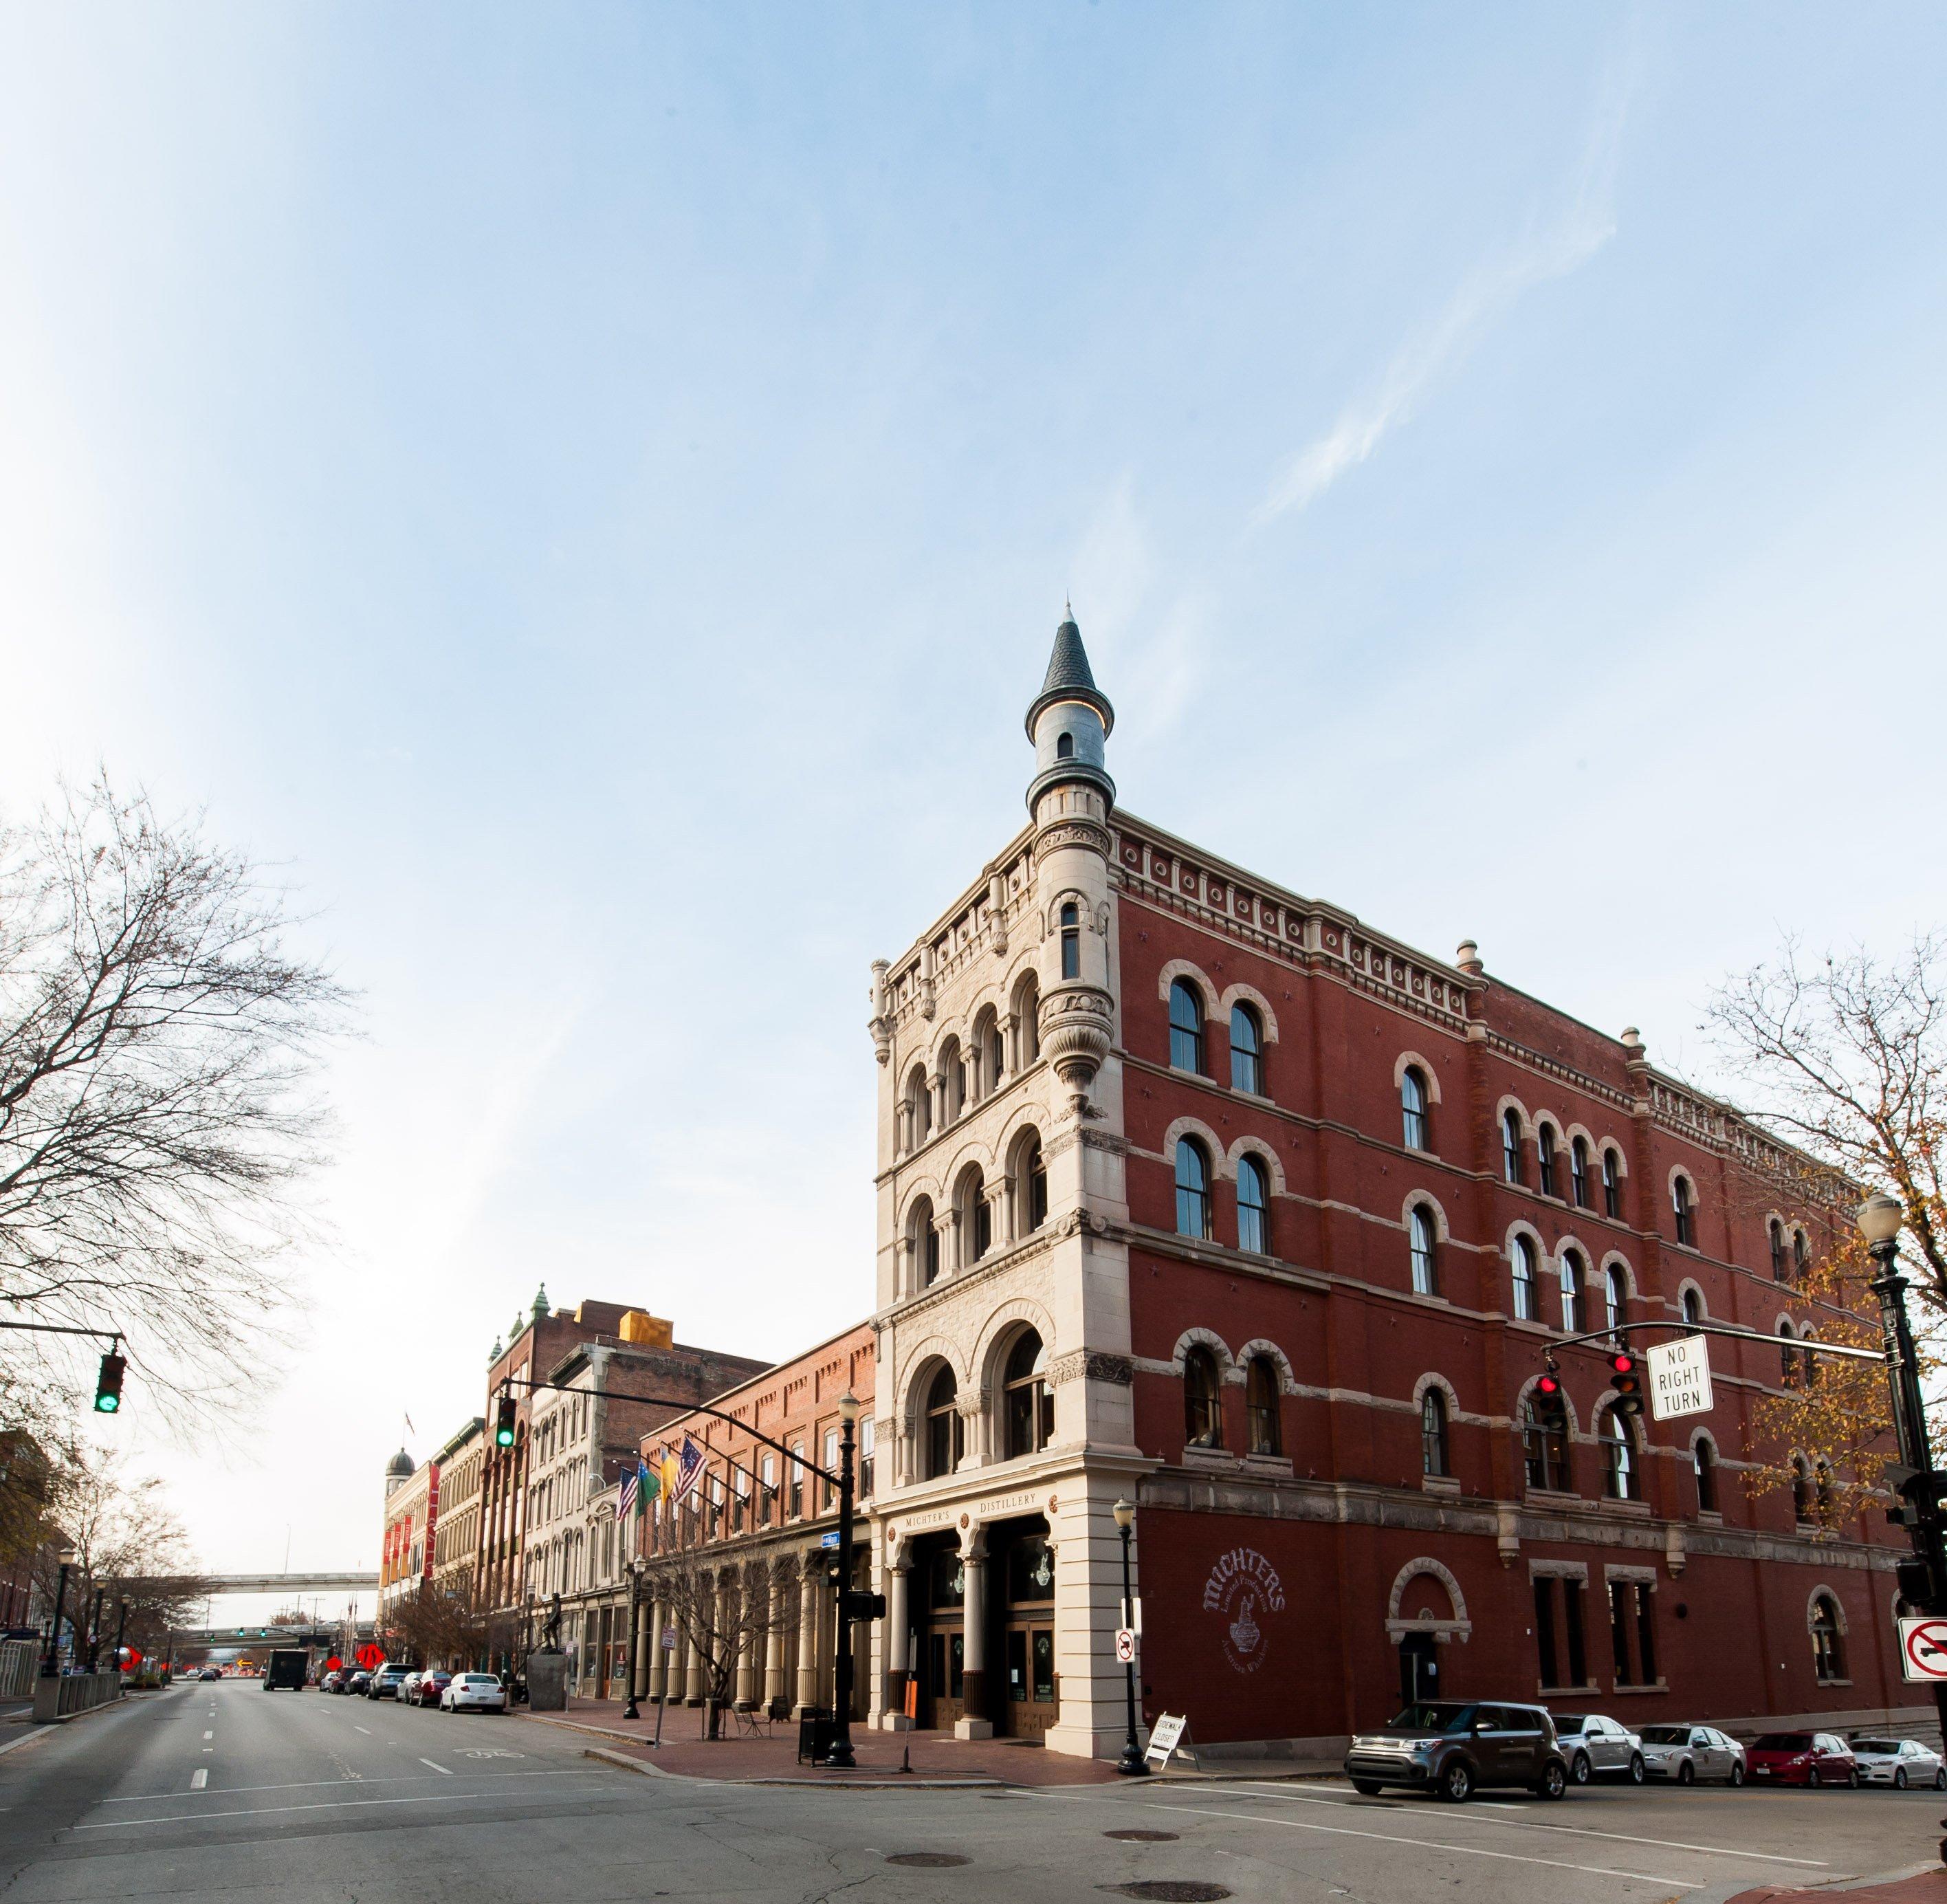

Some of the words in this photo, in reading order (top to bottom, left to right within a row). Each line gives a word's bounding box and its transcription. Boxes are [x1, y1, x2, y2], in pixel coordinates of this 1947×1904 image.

[1667, 1346, 1686, 1366] NO
[1659, 1366, 1699, 1390] RIGHT
[1664, 1390, 1700, 1412] TURN
[905, 1511, 950, 1527] MICHTER'S
[980, 1493, 1036, 1513] DISTILLERY
[1203, 1547, 1286, 1612] MICHTER'S
[1220, 1577, 1240, 1612] Limited
[1240, 1574, 1268, 1612] Production
[1221, 1640, 1245, 1674] American
[1155, 1732, 1174, 1743] CLOSED
[1157, 1720, 1181, 1731] SIDEWALK
